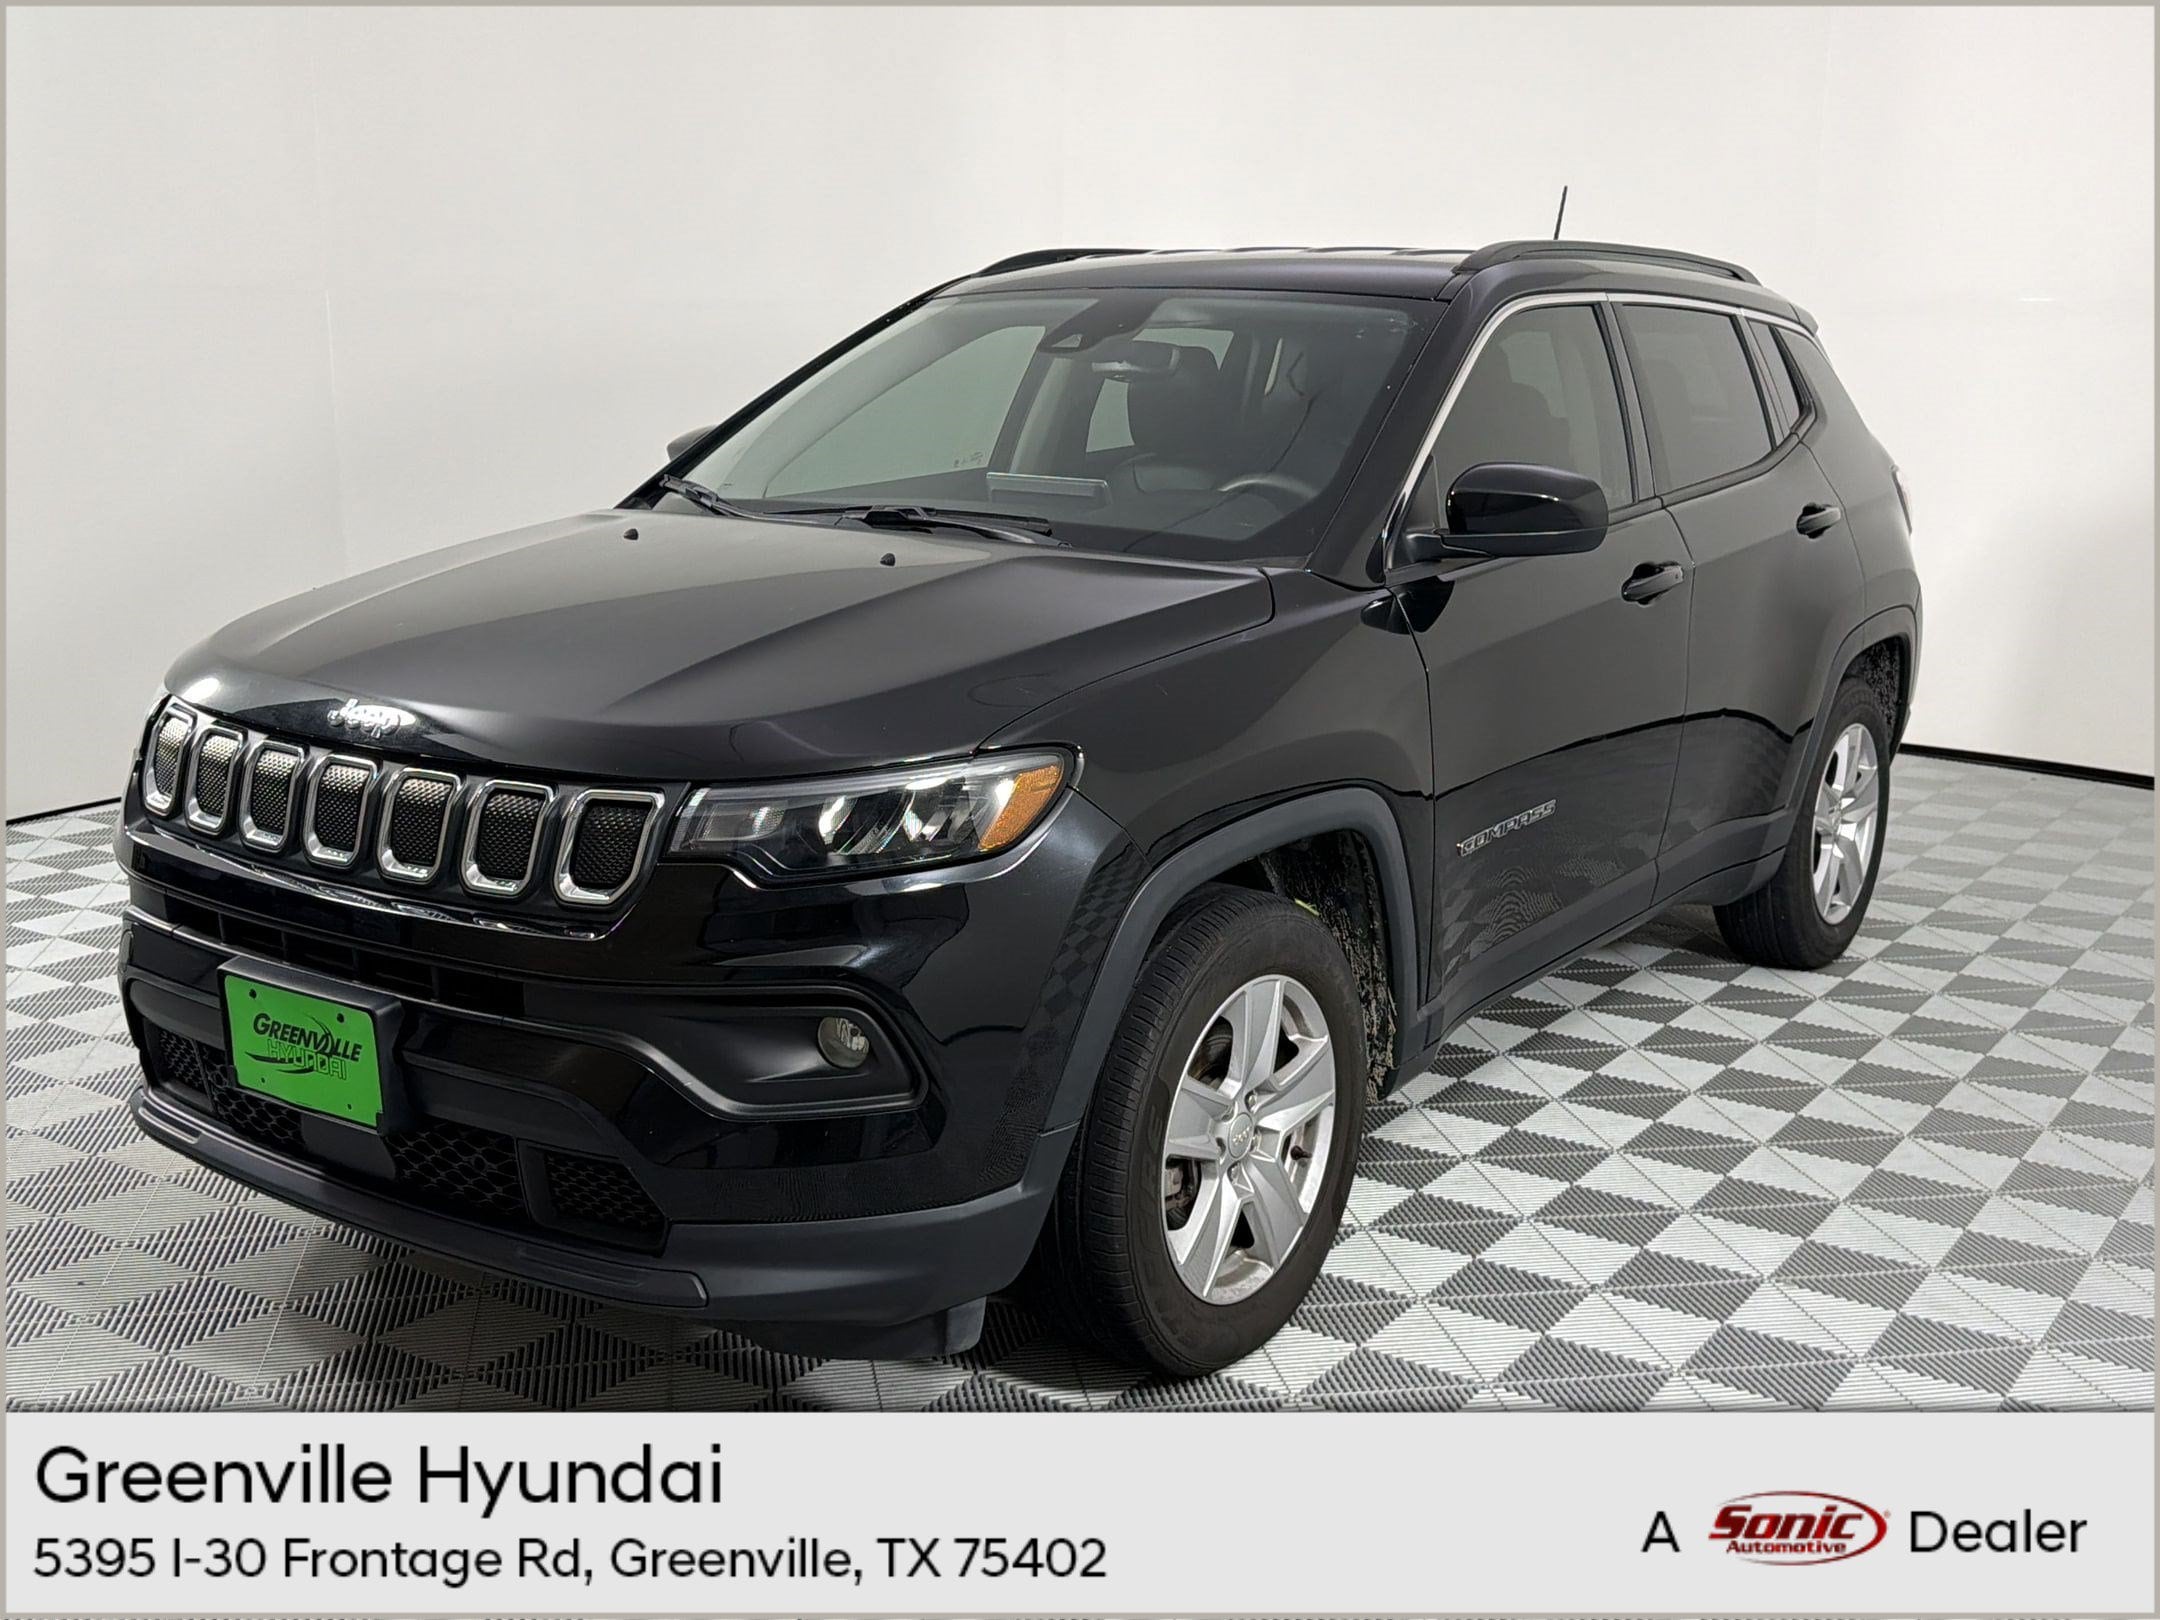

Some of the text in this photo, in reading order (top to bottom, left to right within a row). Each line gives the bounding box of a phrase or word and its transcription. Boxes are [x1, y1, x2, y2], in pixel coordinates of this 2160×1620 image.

[326, 698, 401, 739] Jeep
[1456, 799, 1557, 857] COMPASS
[253, 1012, 363, 1063] GREENVILLE
[267, 1039, 347, 1081] HYUNDAI
